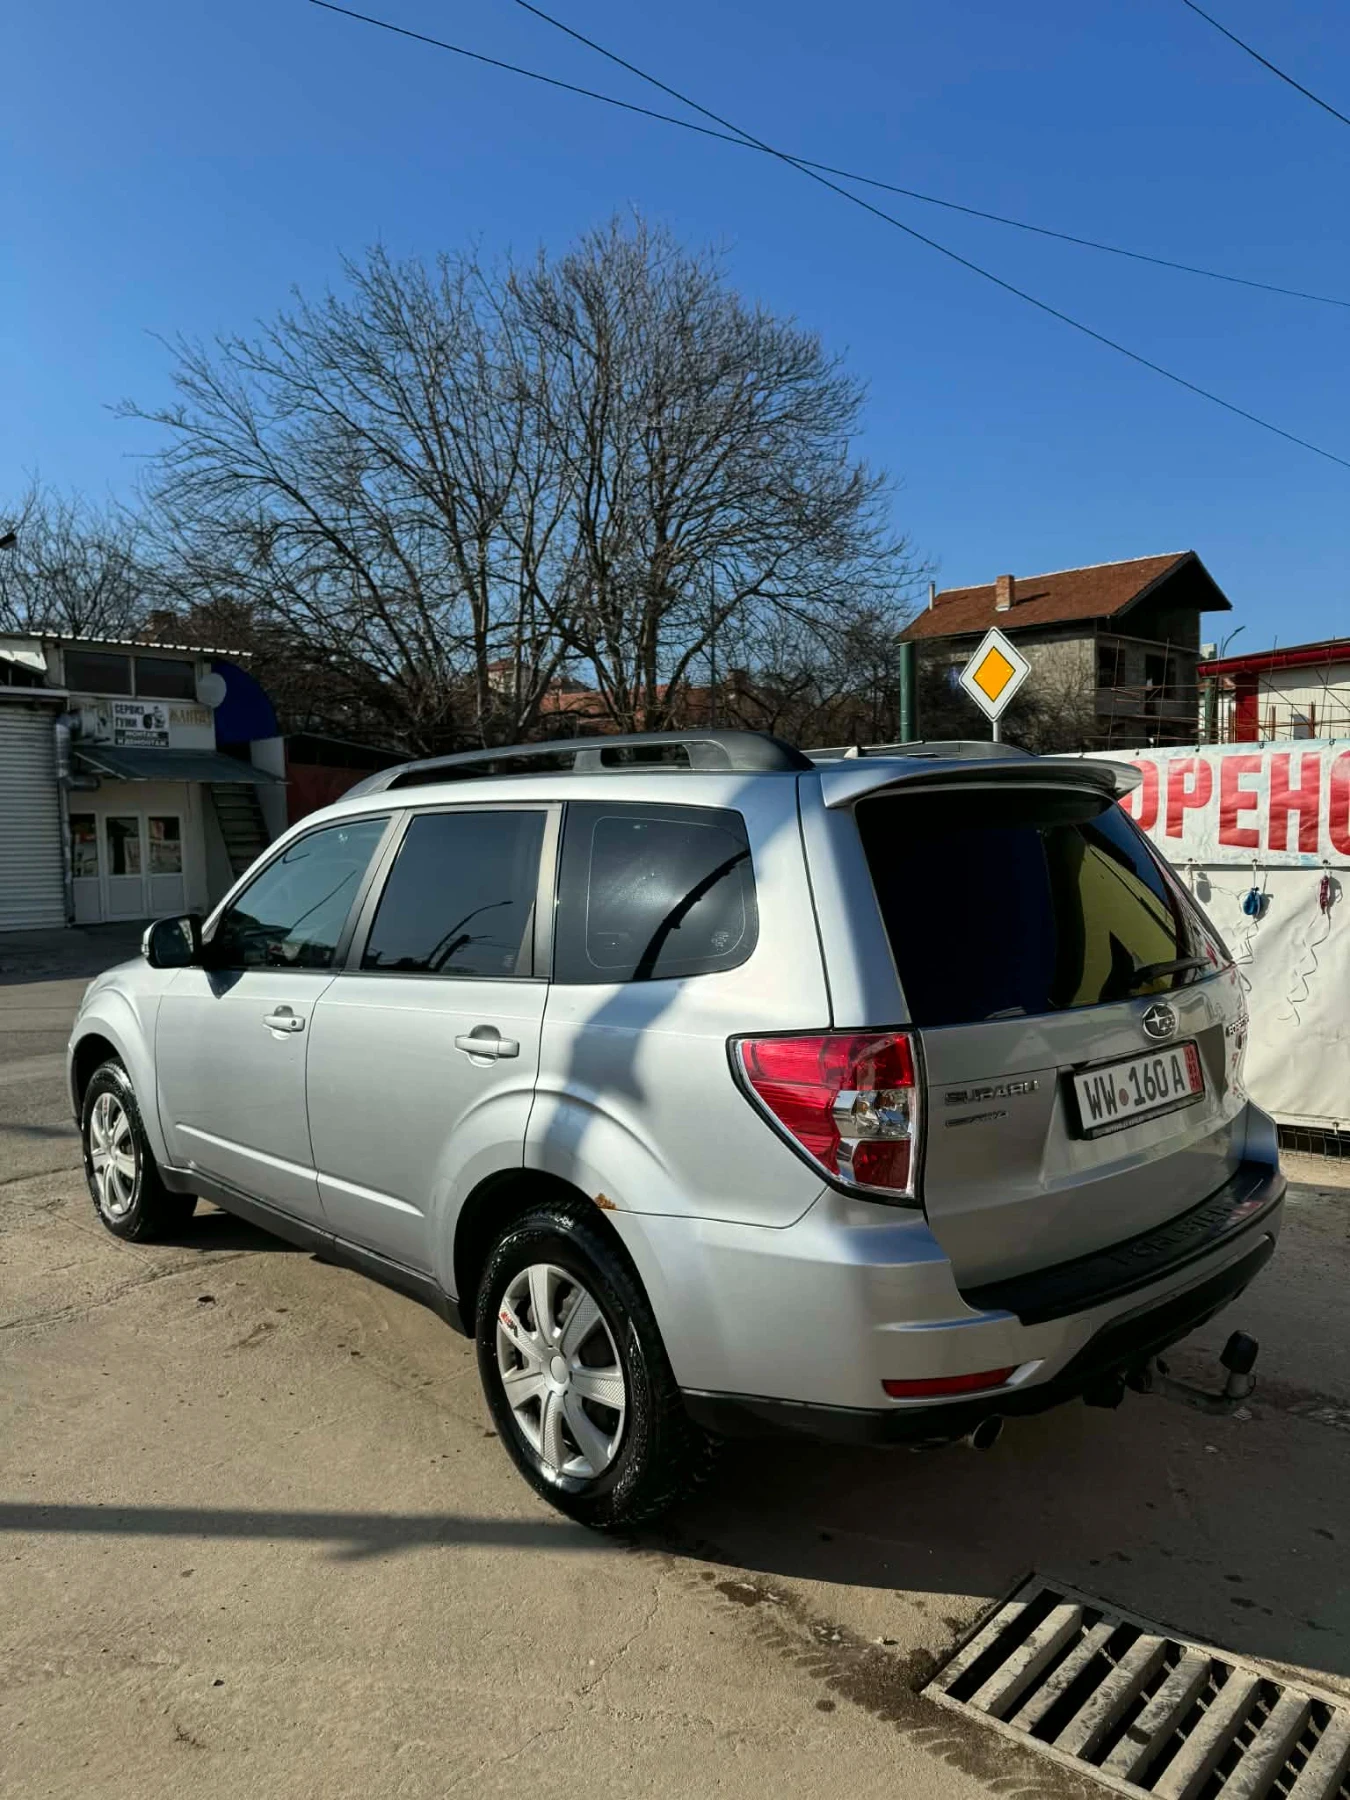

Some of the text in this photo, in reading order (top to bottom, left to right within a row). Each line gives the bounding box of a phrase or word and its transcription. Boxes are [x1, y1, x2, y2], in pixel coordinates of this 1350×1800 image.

[944, 1079, 1040, 1106] SUBARU
[1083, 1073, 1118, 1120] WW
[1128, 1059, 1169, 1106] 160
[1170, 1054, 1186, 1093] A
